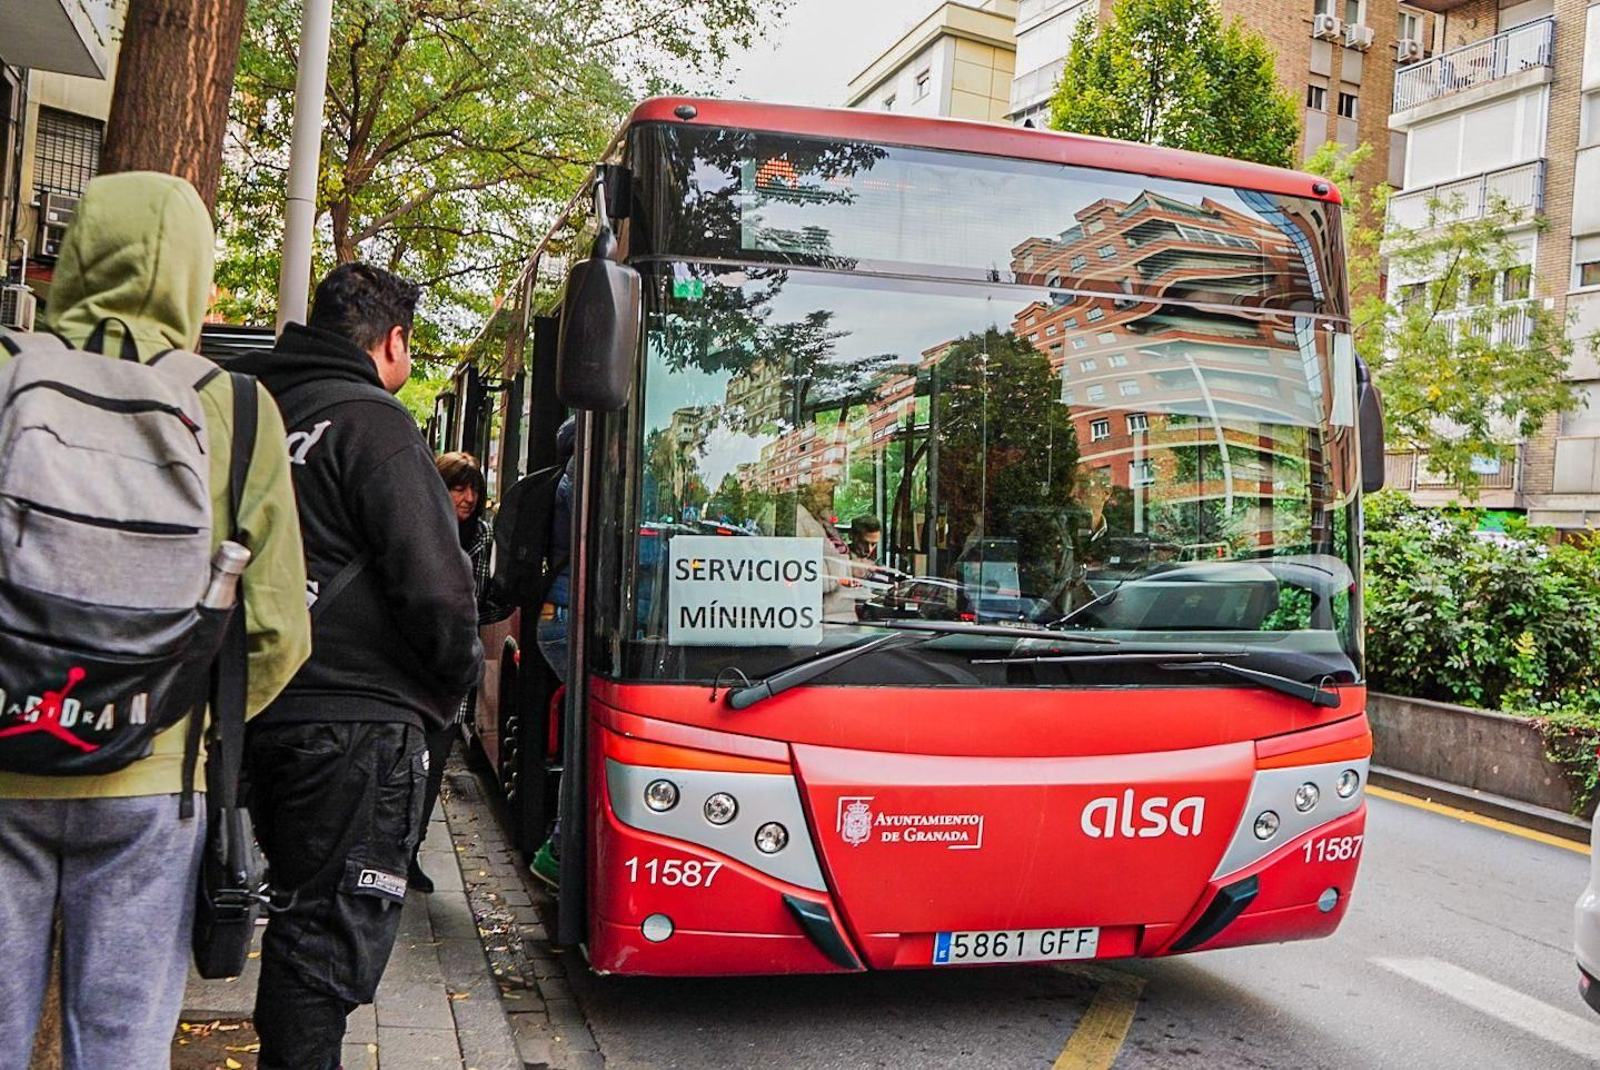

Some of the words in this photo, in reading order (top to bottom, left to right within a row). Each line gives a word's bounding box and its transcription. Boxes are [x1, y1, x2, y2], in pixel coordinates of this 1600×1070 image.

[675, 558, 818, 582] SERVICIOS
[680, 600, 814, 629] MÍNIMOS
[874, 812, 979, 827] AYUNTAMIENTO
[1081, 788, 1206, 839] alsa
[881, 831, 900, 843] DE
[903, 827, 969, 843] GRANADA
[1302, 834, 1364, 864] 11587
[624, 856, 724, 888] 11587
[954, 931, 1025, 959] 5861
[1040, 929, 1094, 956] GFF
